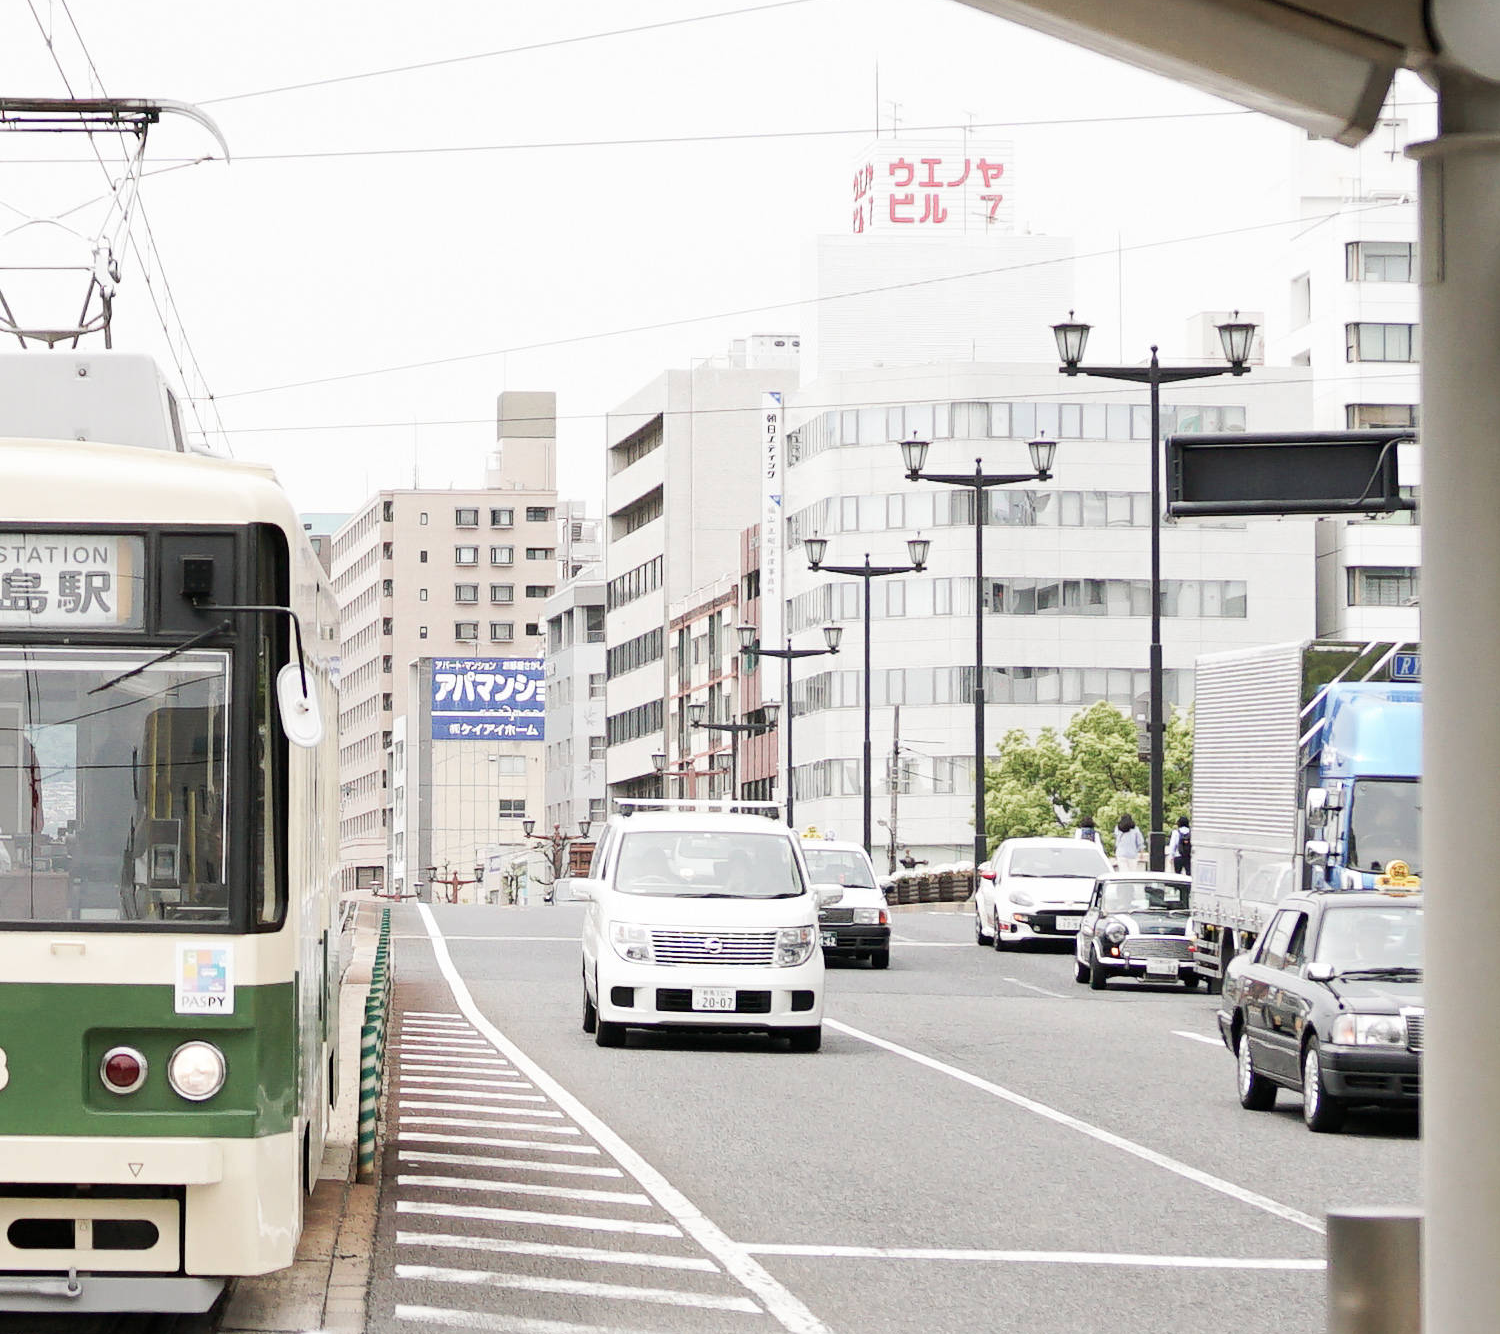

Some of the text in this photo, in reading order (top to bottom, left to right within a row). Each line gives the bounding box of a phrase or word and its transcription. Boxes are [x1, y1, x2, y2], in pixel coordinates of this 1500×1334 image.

[889, 157, 1004, 188] ウエノヤ
[889, 193, 948, 224] ビル
[181, 995, 226, 1008] PASPY
[702, 997, 733, 1009] 20-07
